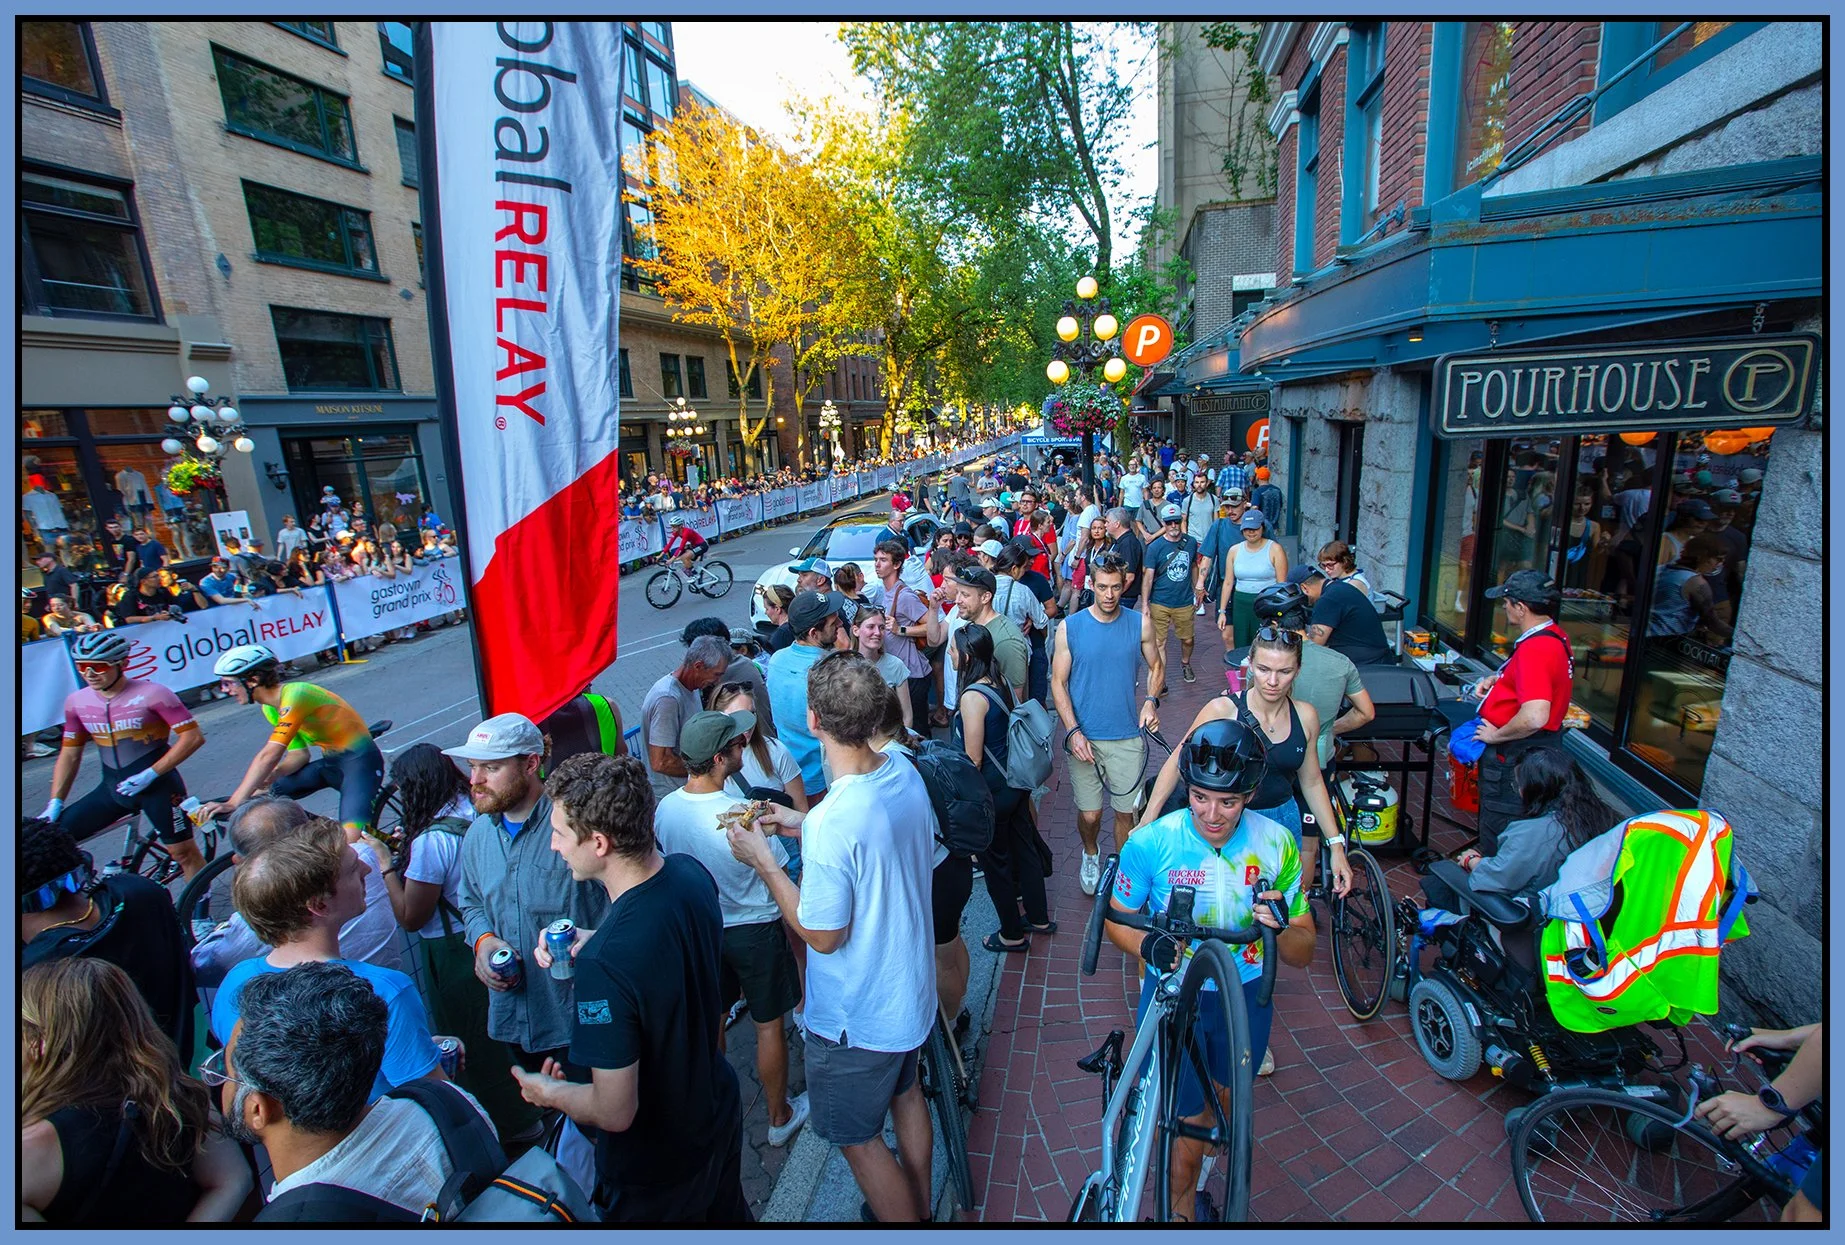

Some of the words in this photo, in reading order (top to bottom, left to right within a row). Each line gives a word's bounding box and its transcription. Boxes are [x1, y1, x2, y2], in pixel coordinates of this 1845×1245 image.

[1135, 325, 1160, 357] P
[1456, 358, 1711, 419] POURHOUSE
[1193, 397, 1252, 413] RESTAURANT
[371, 580, 421, 604] gastown
[373, 594, 409, 619] grand
[411, 590, 432, 609] prix
[1114, 1049, 1156, 1222] ARNEAU
